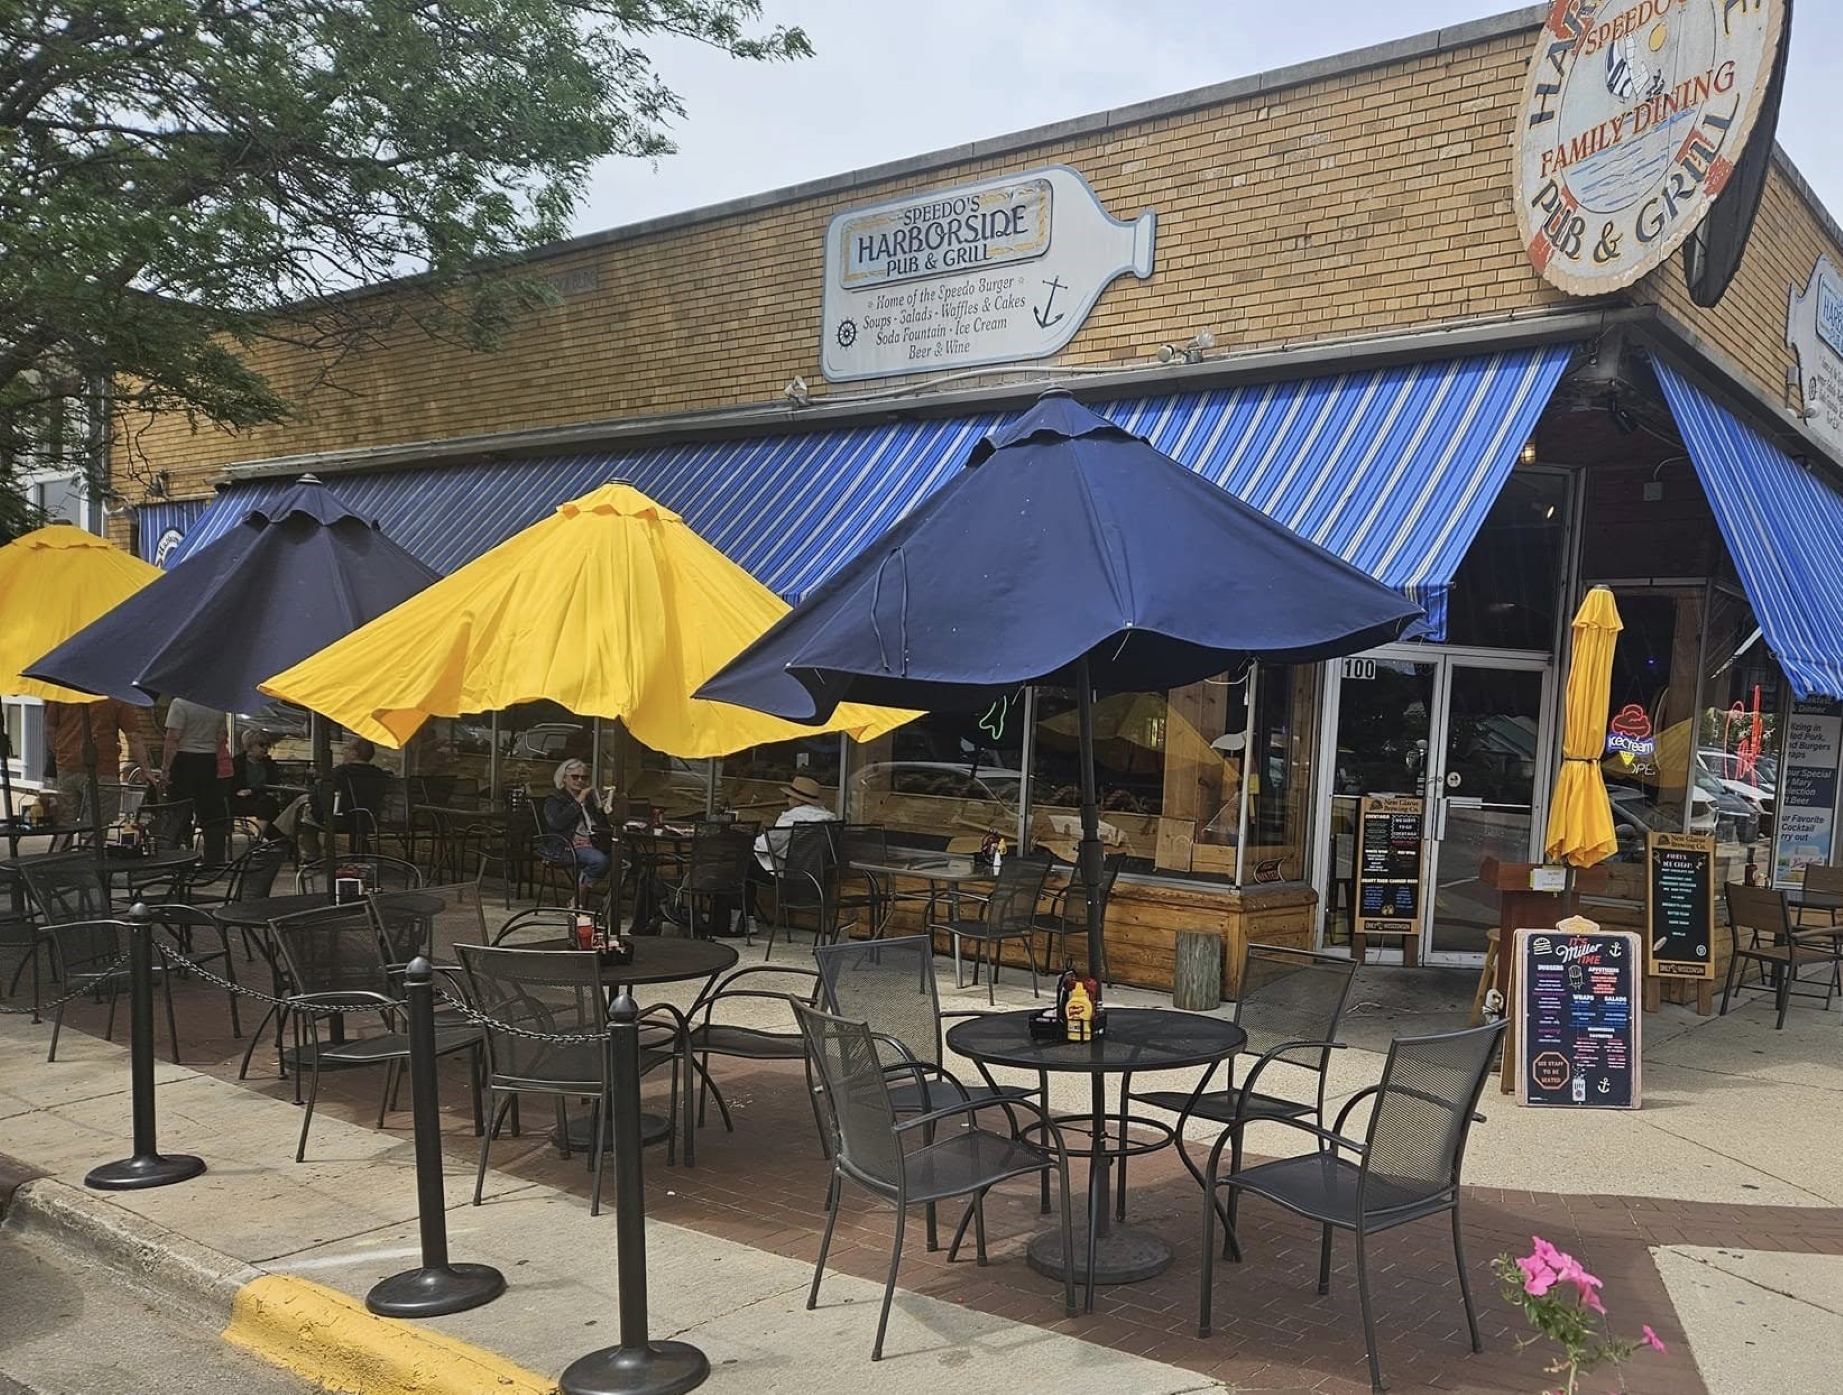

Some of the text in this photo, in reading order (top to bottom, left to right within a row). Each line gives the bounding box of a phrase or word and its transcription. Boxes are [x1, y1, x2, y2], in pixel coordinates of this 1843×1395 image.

[1585, 0, 1673, 56] SPEEDO
[1539, 60, 1737, 179] FAMILY DINING
[1531, 93, 1741, 264] PUB & GRILL
[903, 195, 980, 226] SPEEDO'S
[858, 204, 1029, 263] HARBORSIDE
[886, 244, 992, 277] PUB & GRILL
[876, 277, 1015, 310] Home of the Speedo Burger
[862, 294, 1027, 331] Soups Salads Waffles & Cakes
[876, 317, 1007, 346] Soda Fountain Ice Cream
[909, 340, 970, 360] Beer & Wine
[1345, 660, 1375, 678] 100
[1813, 723, 1822, 732] in
[1799, 742, 1831, 752] Burgers
[1791, 778, 1813, 789] Mary
[1801, 769, 1832, 779] Special
[1790, 796, 1810, 805] Beer
[1781, 823, 1816, 833] Cocktail
[1792, 814, 1826, 824] Favorite
[1794, 834, 1809, 842] out
[1569, 937, 1588, 946] IT'S
[1555, 943, 1603, 964] Miller
[1577, 955, 1602, 965] TIME
